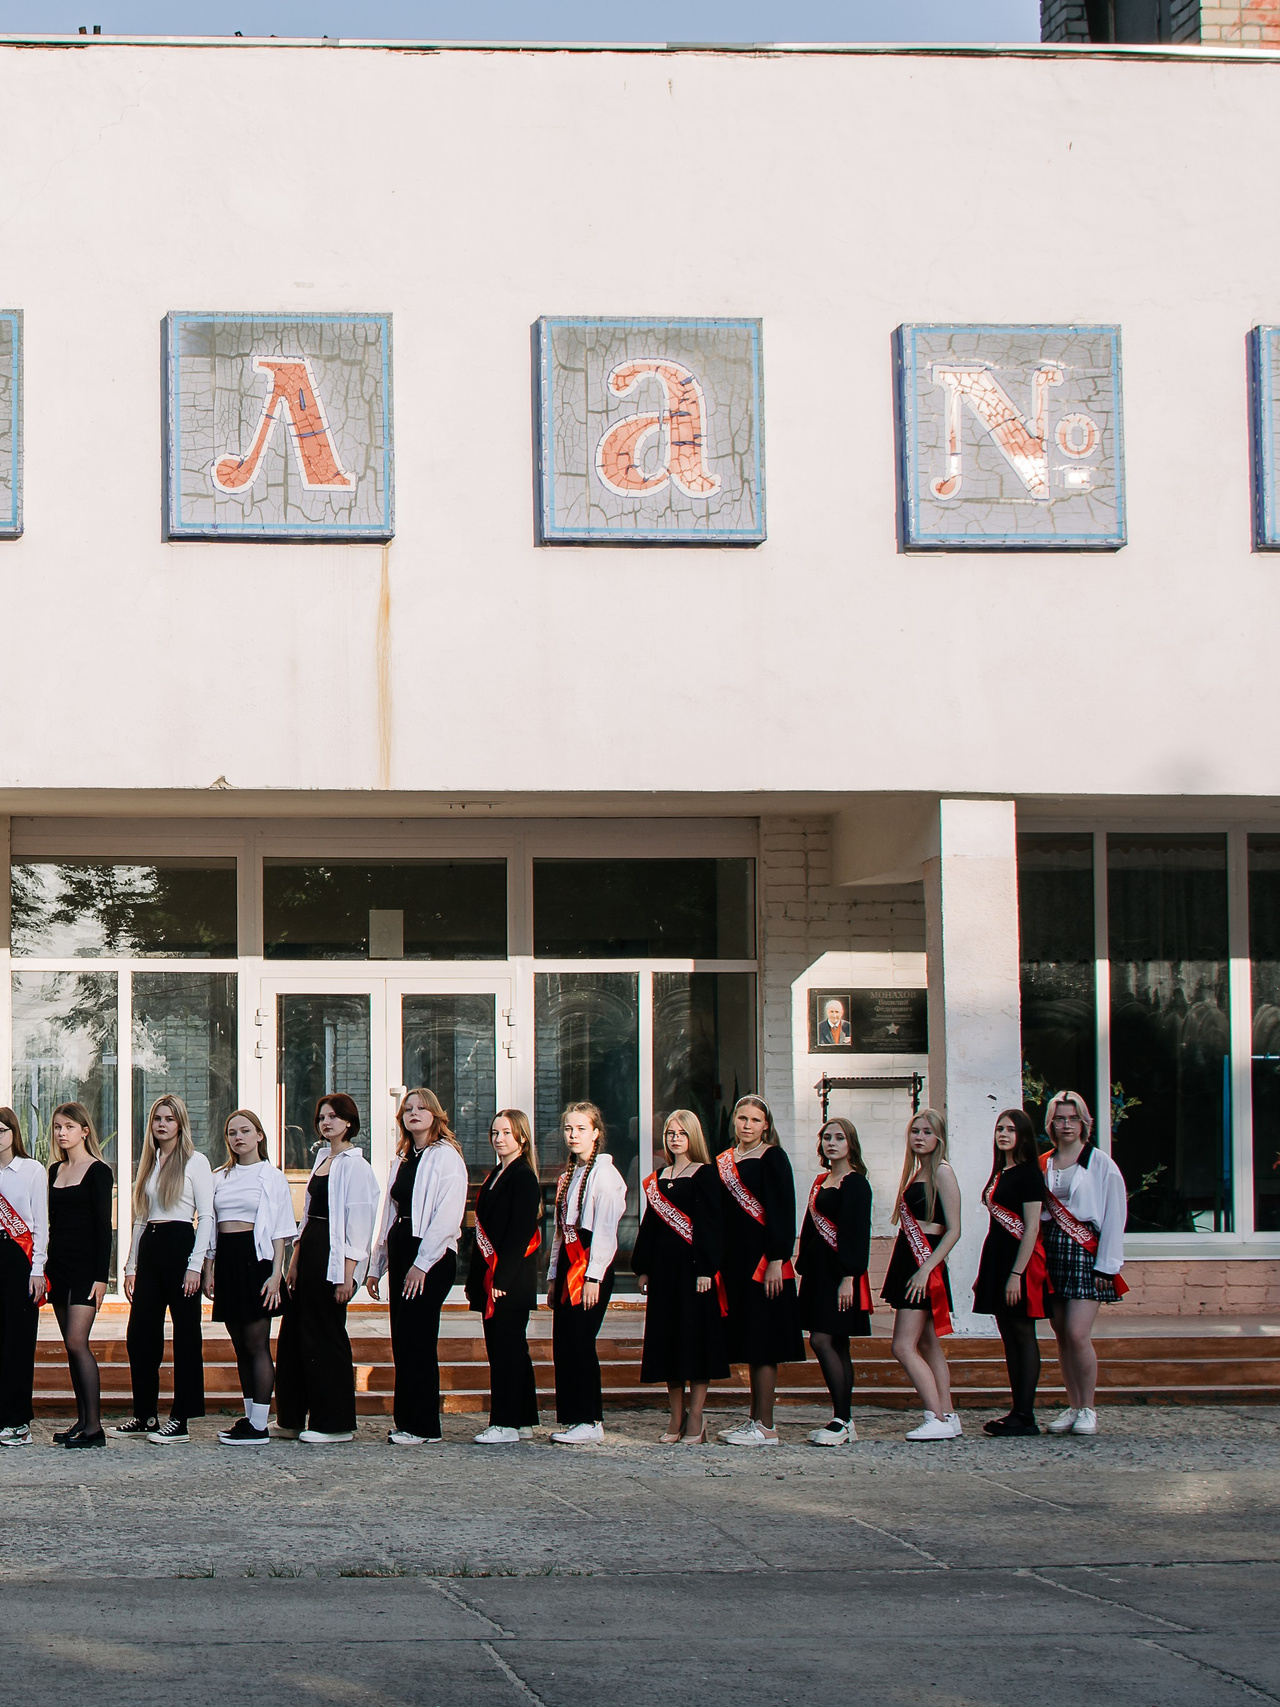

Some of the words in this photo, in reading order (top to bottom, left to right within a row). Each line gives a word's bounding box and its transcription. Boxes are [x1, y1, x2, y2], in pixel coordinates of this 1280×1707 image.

[870, 991, 917, 999] МОНАХОВ
[8, 1215, 27, 1234] 2023
[1072, 1224, 1092, 1241] 2023
